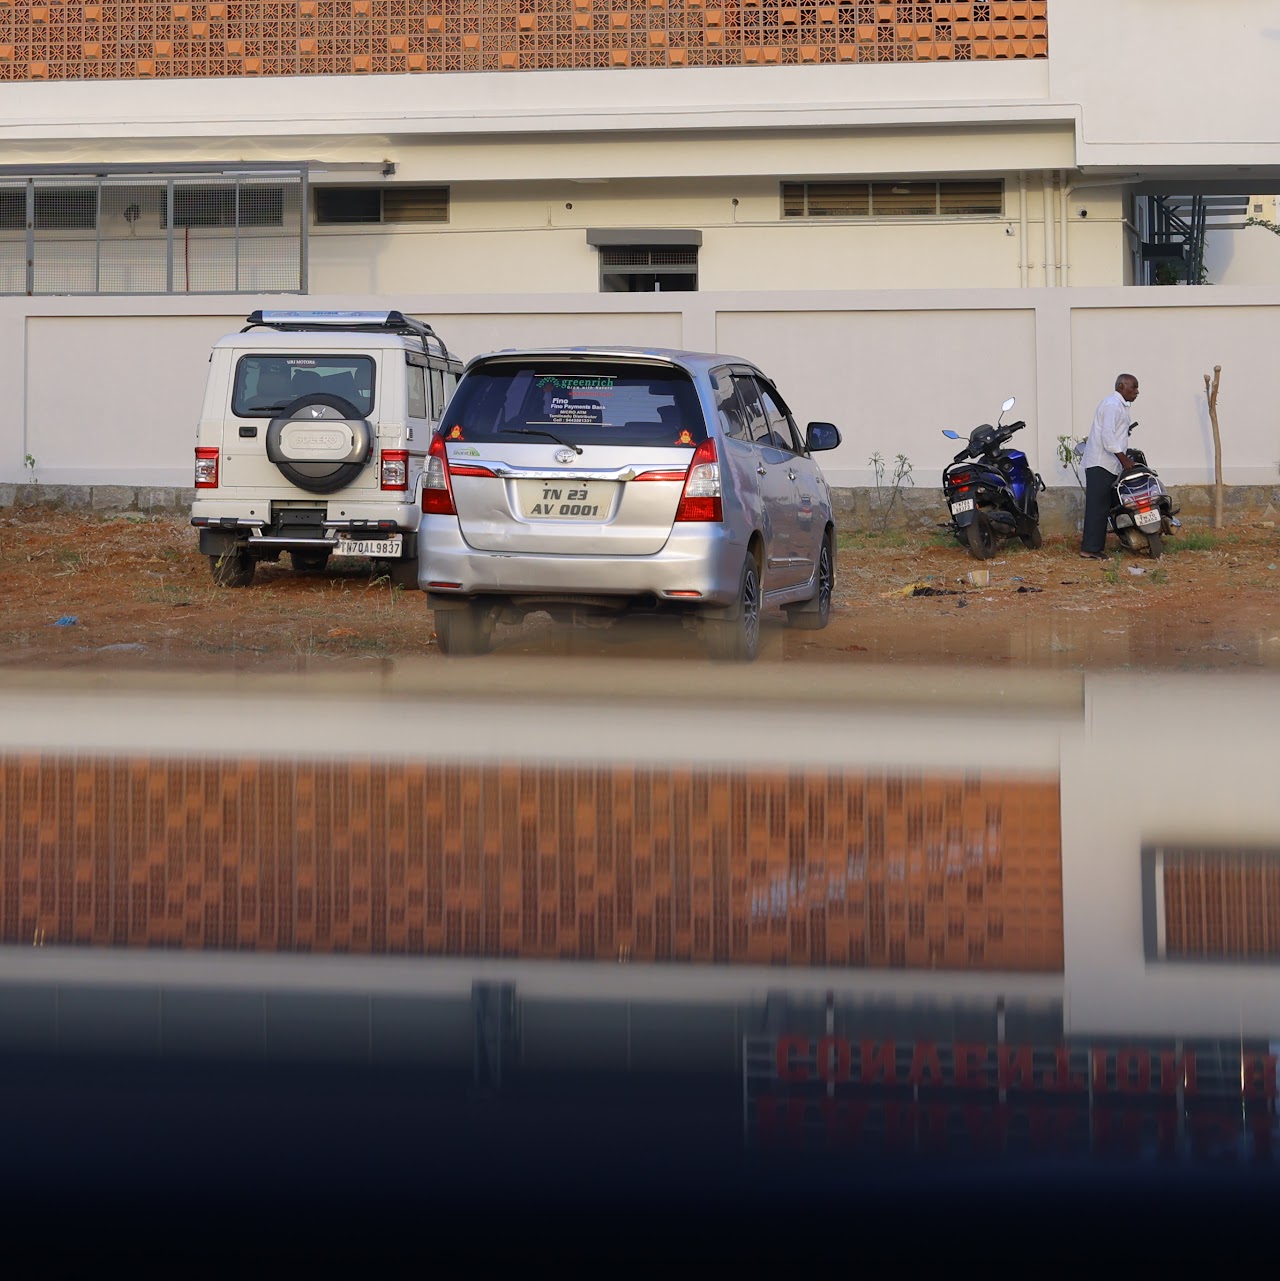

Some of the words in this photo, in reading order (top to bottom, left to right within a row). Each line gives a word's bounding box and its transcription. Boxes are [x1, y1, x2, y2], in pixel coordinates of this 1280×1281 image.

[561, 378, 614, 389] greenrich
[296, 435, 337, 445] BOLERO
[542, 489, 562, 501] TN
[567, 489, 589, 501] 23
[531, 503, 555, 515] AV
[559, 504, 599, 516] 0001
[340, 542, 400, 554] TN70AL9837
